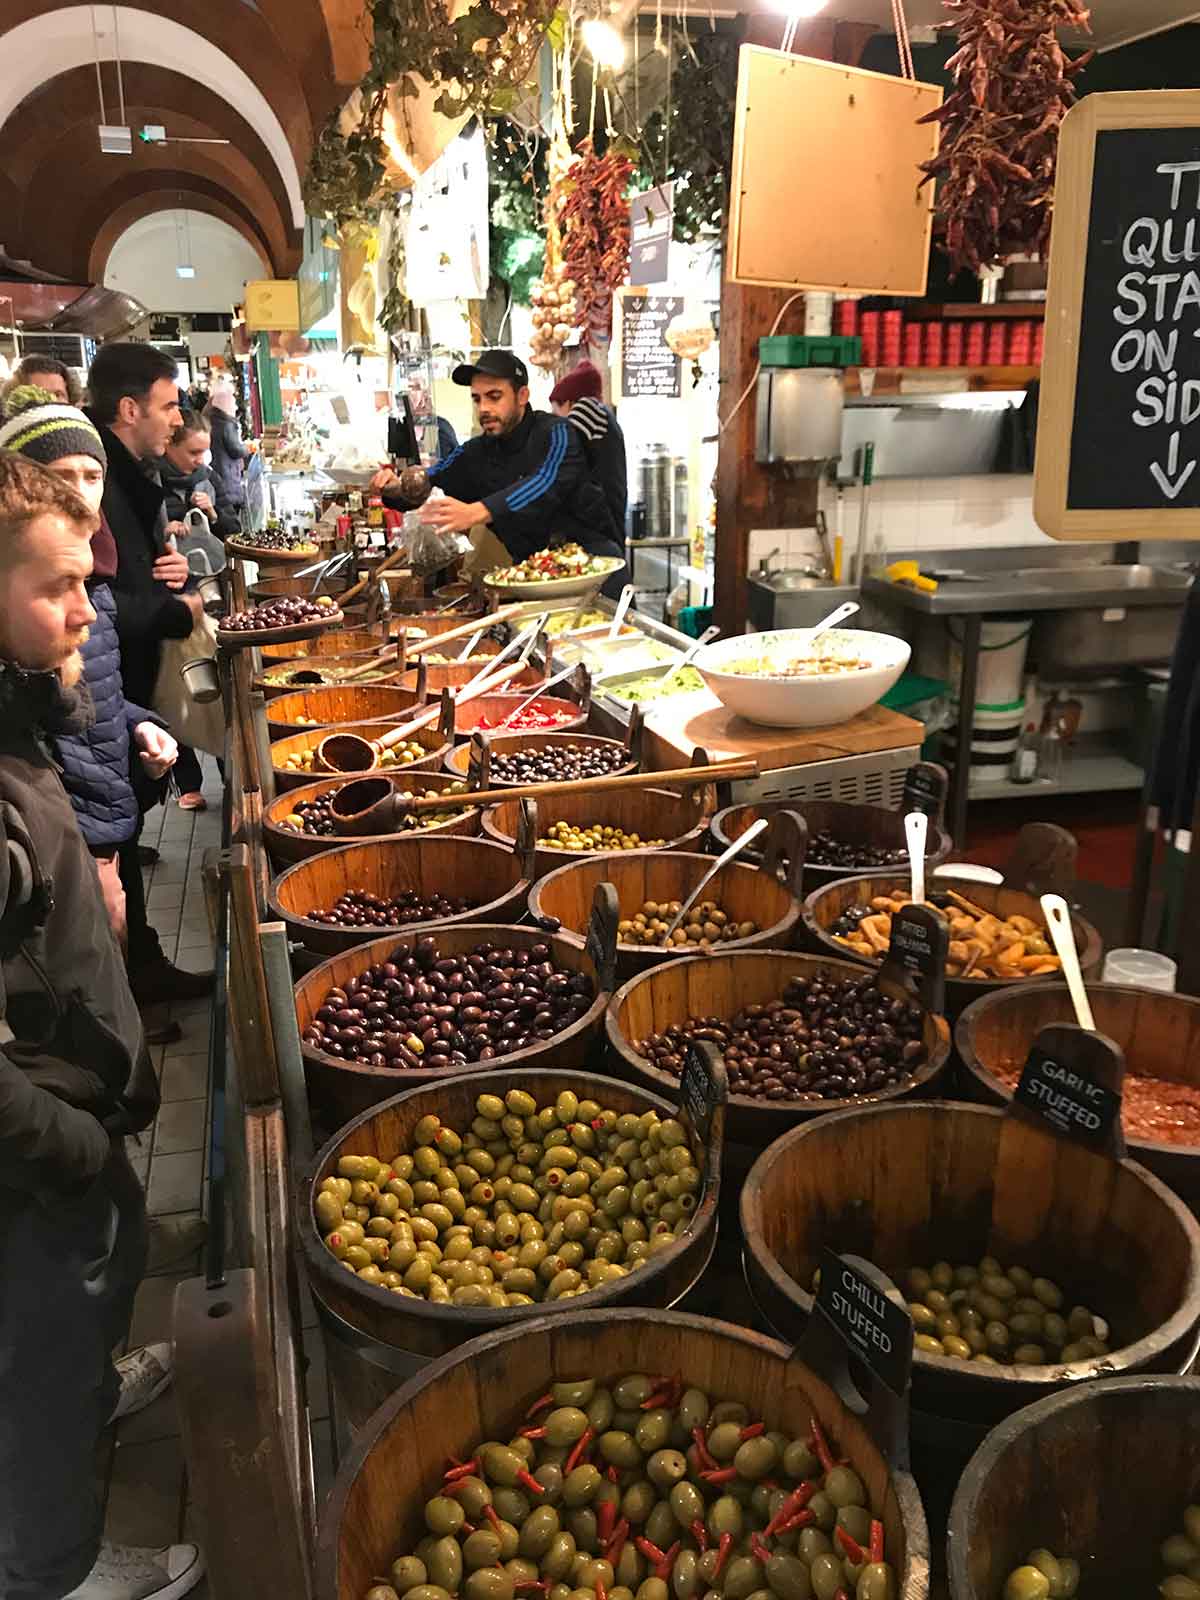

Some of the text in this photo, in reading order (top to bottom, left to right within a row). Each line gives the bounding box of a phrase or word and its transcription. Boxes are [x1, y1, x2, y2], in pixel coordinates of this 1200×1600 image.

[1111, 329, 1178, 373] ON
[1027, 1078, 1101, 1129] STUFFED
[841, 1271, 887, 1319] CHILLI
[831, 1291, 892, 1353] STUFFED
